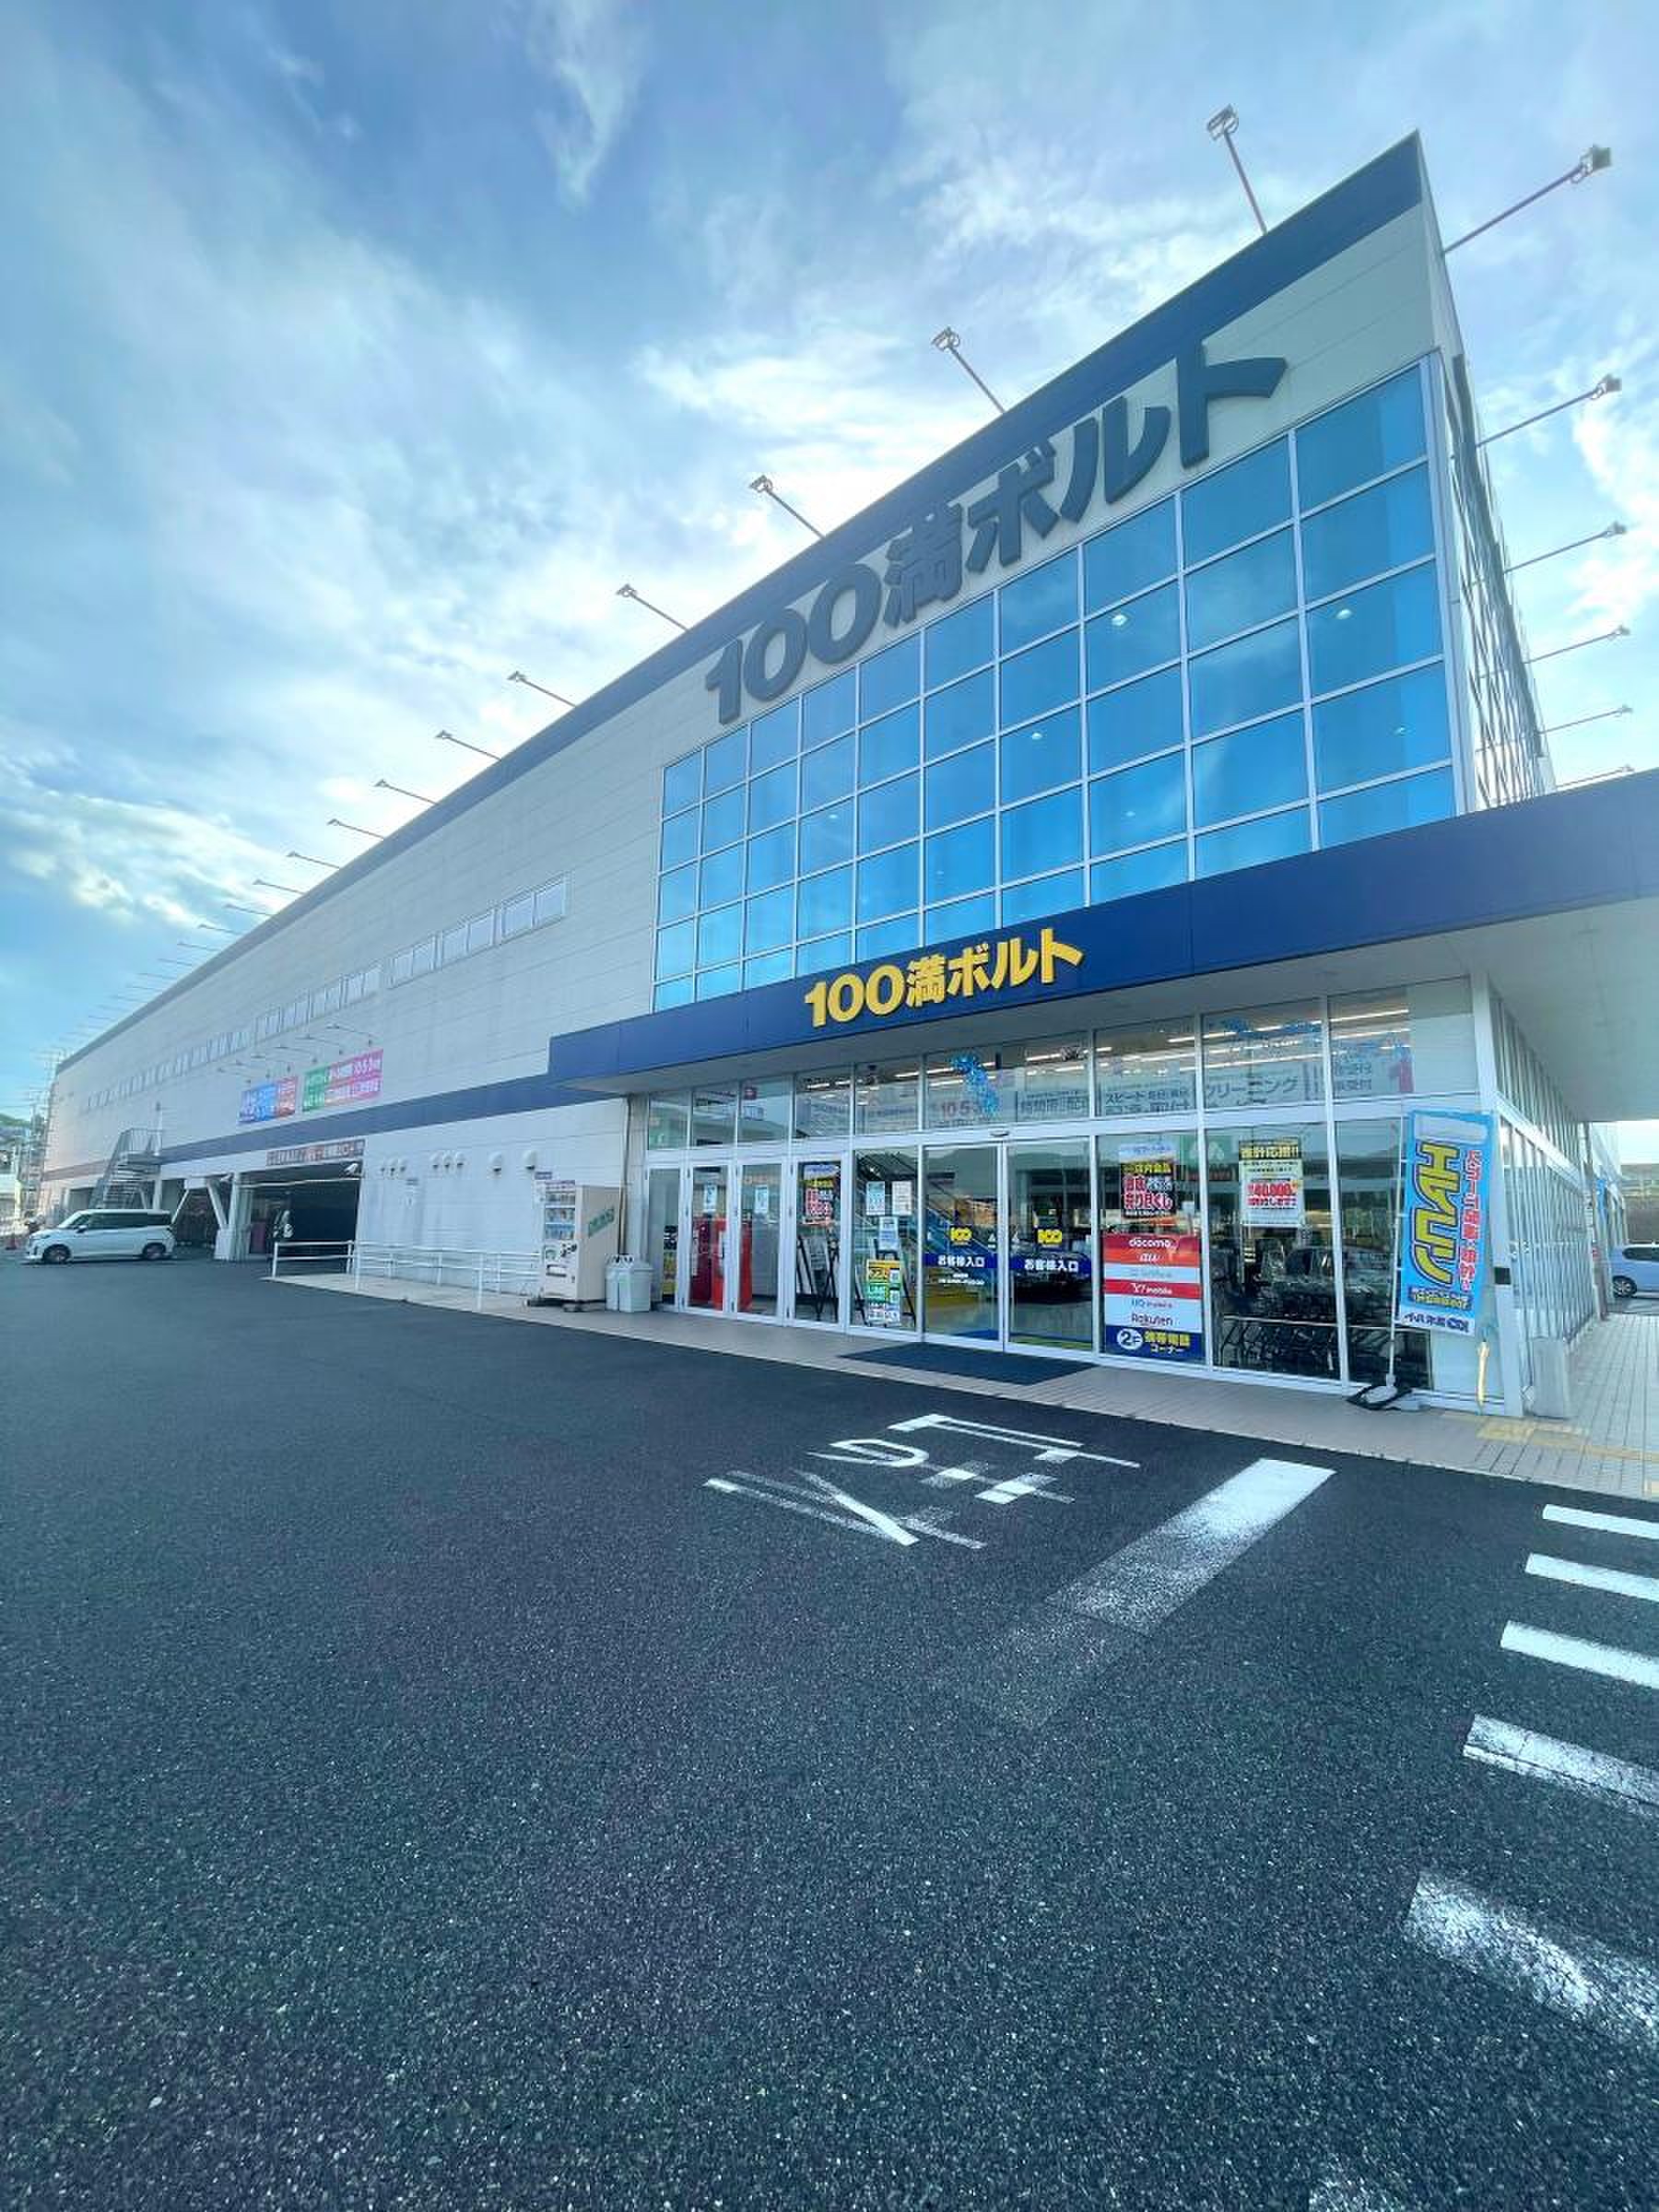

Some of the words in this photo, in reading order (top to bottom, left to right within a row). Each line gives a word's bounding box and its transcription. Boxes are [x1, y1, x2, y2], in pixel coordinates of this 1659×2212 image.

[705, 340, 1287, 724] 100満ボルト
[805, 928, 1083, 1028] 100満ボルト
[1129, 1237, 1171, 1248] docomo
[937, 1254, 985, 1268] お客様入口
[1139, 1253, 1159, 1262] au
[1024, 1258, 1078, 1272] お客様入口
[1131, 1312, 1174, 1326] Rakuten
